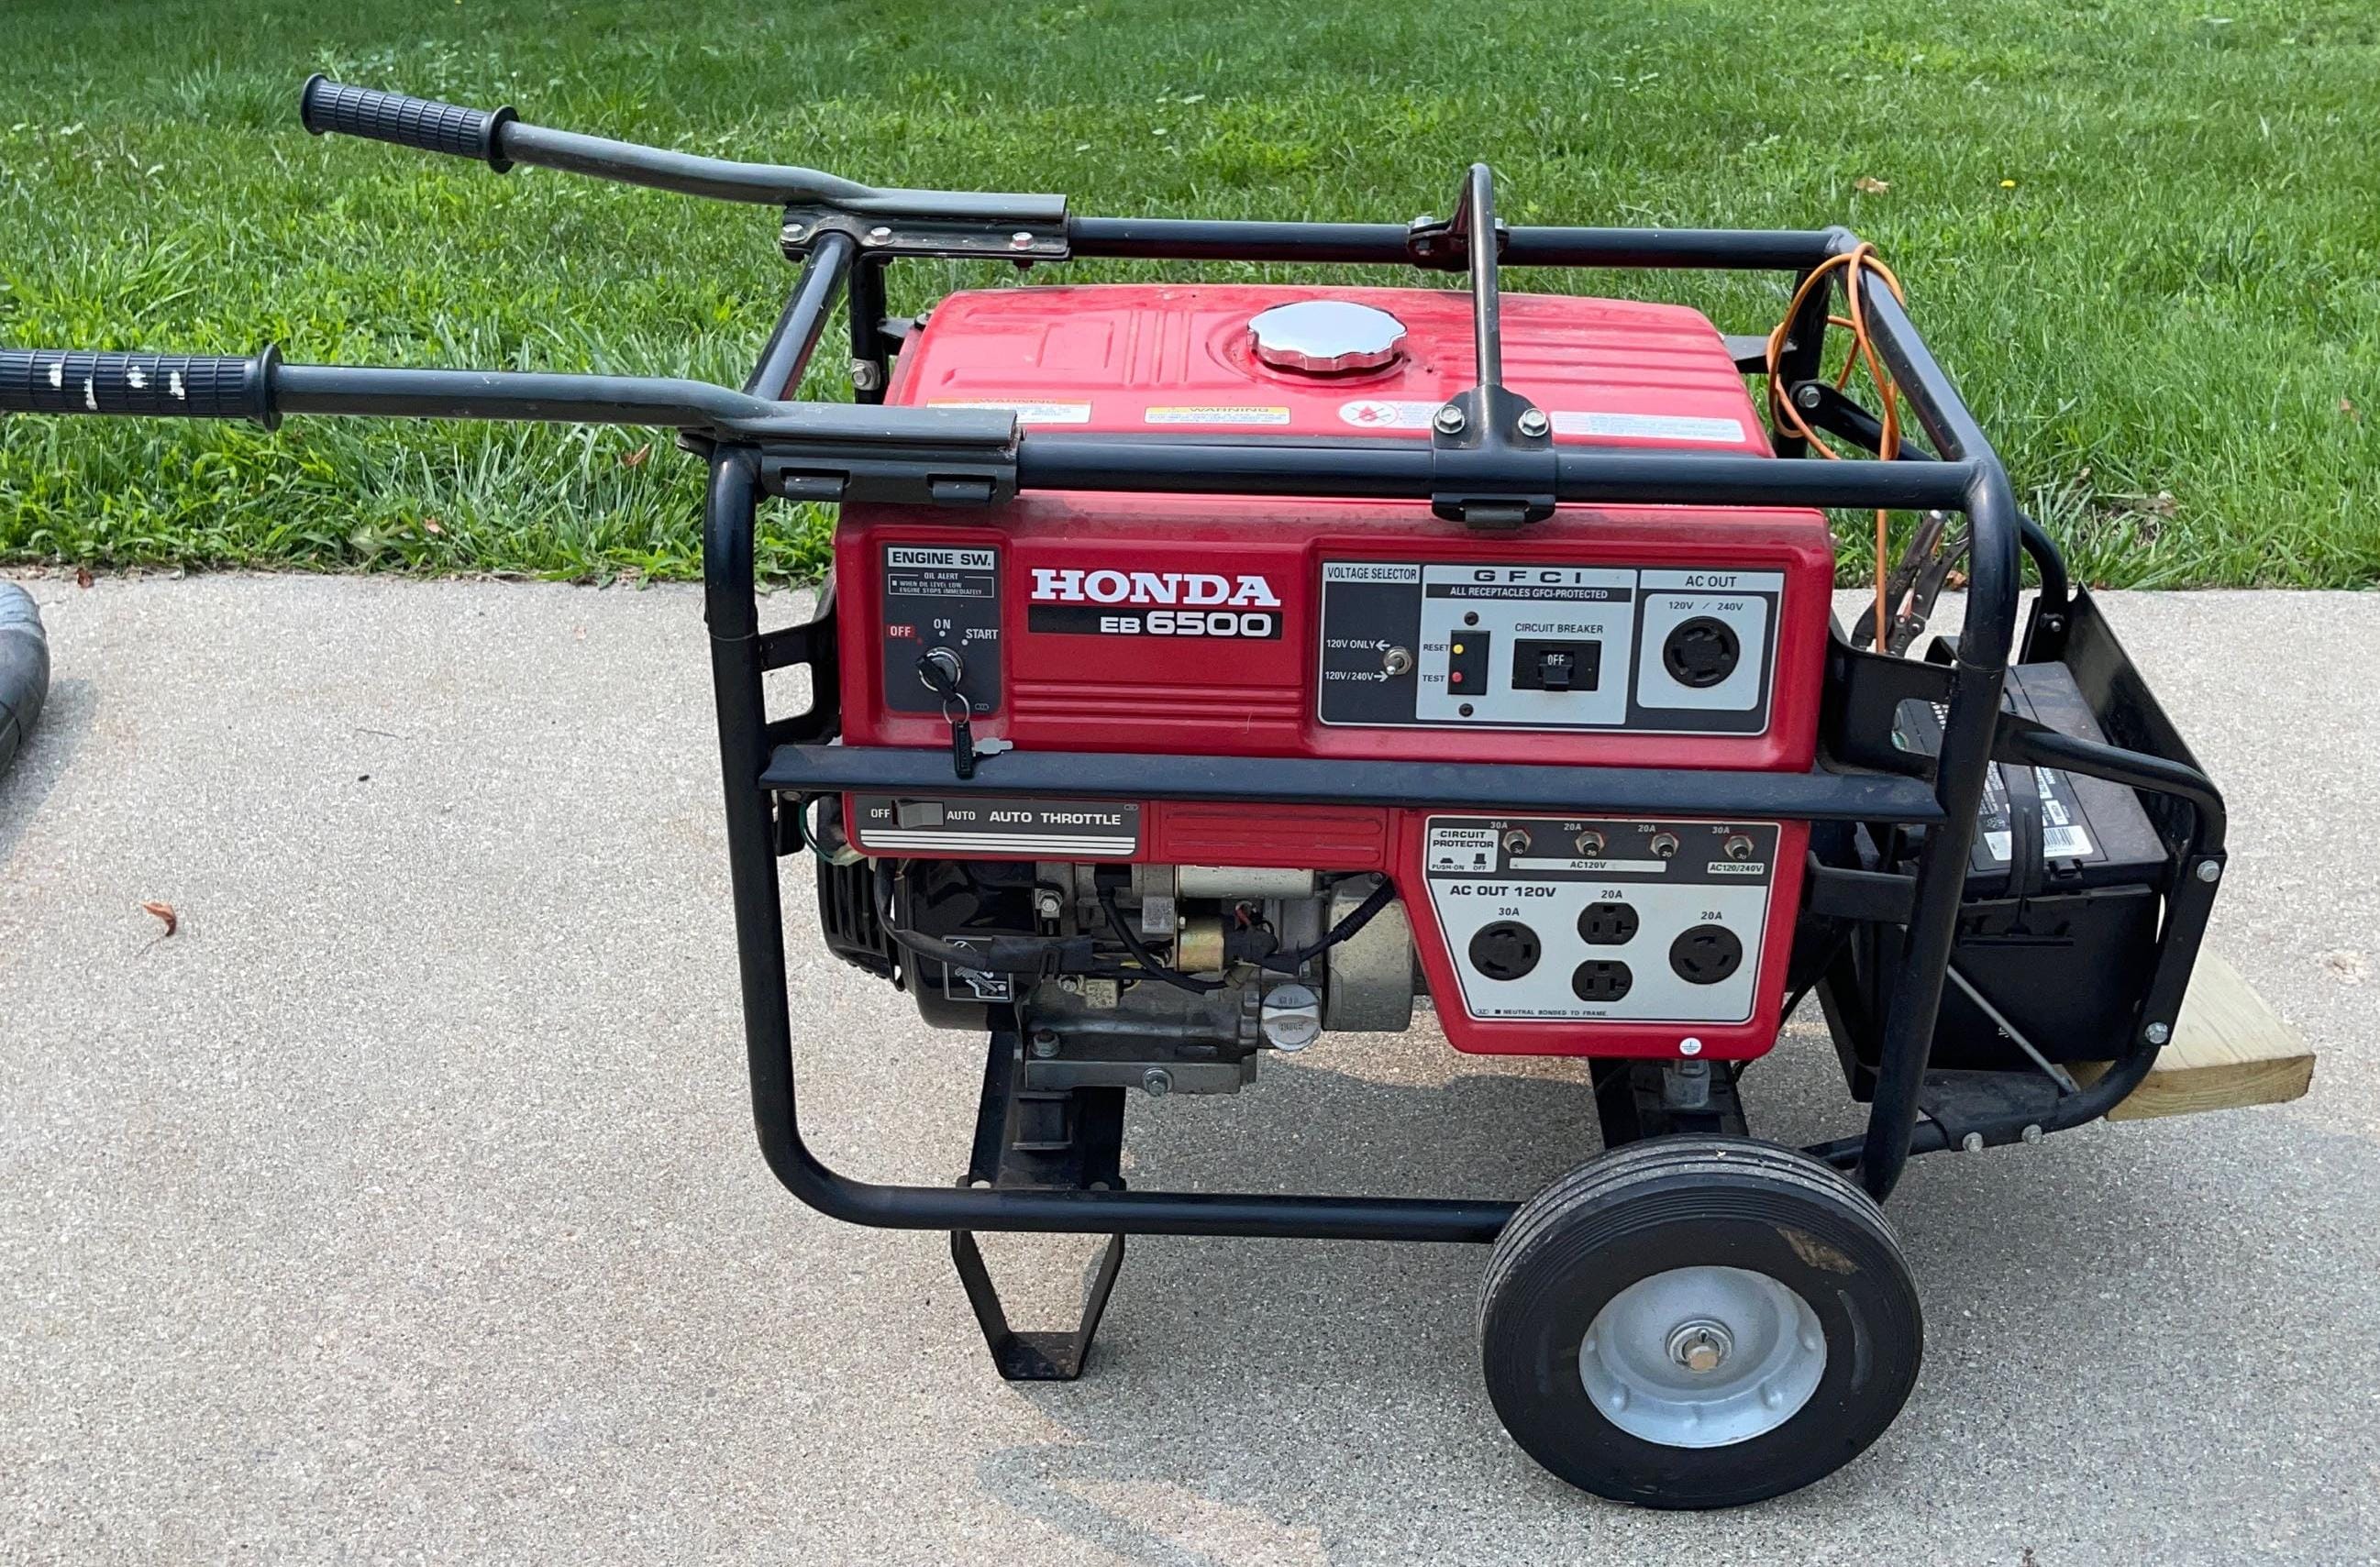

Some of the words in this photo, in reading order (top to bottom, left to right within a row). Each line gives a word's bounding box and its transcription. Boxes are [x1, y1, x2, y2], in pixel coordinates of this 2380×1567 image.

[891, 551, 954, 565] ENGINE
[960, 553, 991, 566] SW.
[1327, 567, 1368, 579] VOLTAGE
[1371, 568, 1416, 579] SELECTOR
[1474, 570, 1581, 583] GFCI
[1685, 576, 1703, 587] AC
[1708, 577, 1737, 587] OUT
[1031, 568, 1281, 606] HONDA
[1450, 587, 1466, 596] ALL
[1468, 588, 1530, 598] RECEPTACLES
[1532, 589, 1608, 599] GFCI-PROTECTED
[1668, 601, 1694, 610] 120V
[1717, 602, 1743, 611] 240V
[934, 619, 951, 629] ON
[1101, 616, 1140, 634] EB
[1146, 611, 1271, 636] 6500
[1515, 623, 1554, 633] CIRCUIT
[1557, 624, 1603, 634] BREAKER
[891, 626, 911, 636] OFF
[966, 629, 999, 639] START
[1326, 639, 1348, 647] 120V
[1350, 640, 1376, 649] ONLY
[1422, 644, 1449, 652] RESET
[1547, 654, 1565, 666] OFF
[870, 808, 890, 819] OFF
[946, 811, 975, 821] AUTO
[990, 811, 1032, 822] AUTO
[1040, 812, 1121, 825] THROTTLE
[1564, 822, 1582, 831] 20A
[1637, 824, 1656, 833] 20A
[1440, 831, 1486, 839] CIRCUIT
[1433, 840, 1494, 848] PROTECTOR
[1450, 886, 1471, 895] AC
[1477, 886, 1509, 896] OUT
[1514, 887, 1556, 897] 120V
[1601, 889, 1622, 899] 20A
[1499, 907, 1519, 916] 30A
[1700, 910, 1722, 920] 20A
